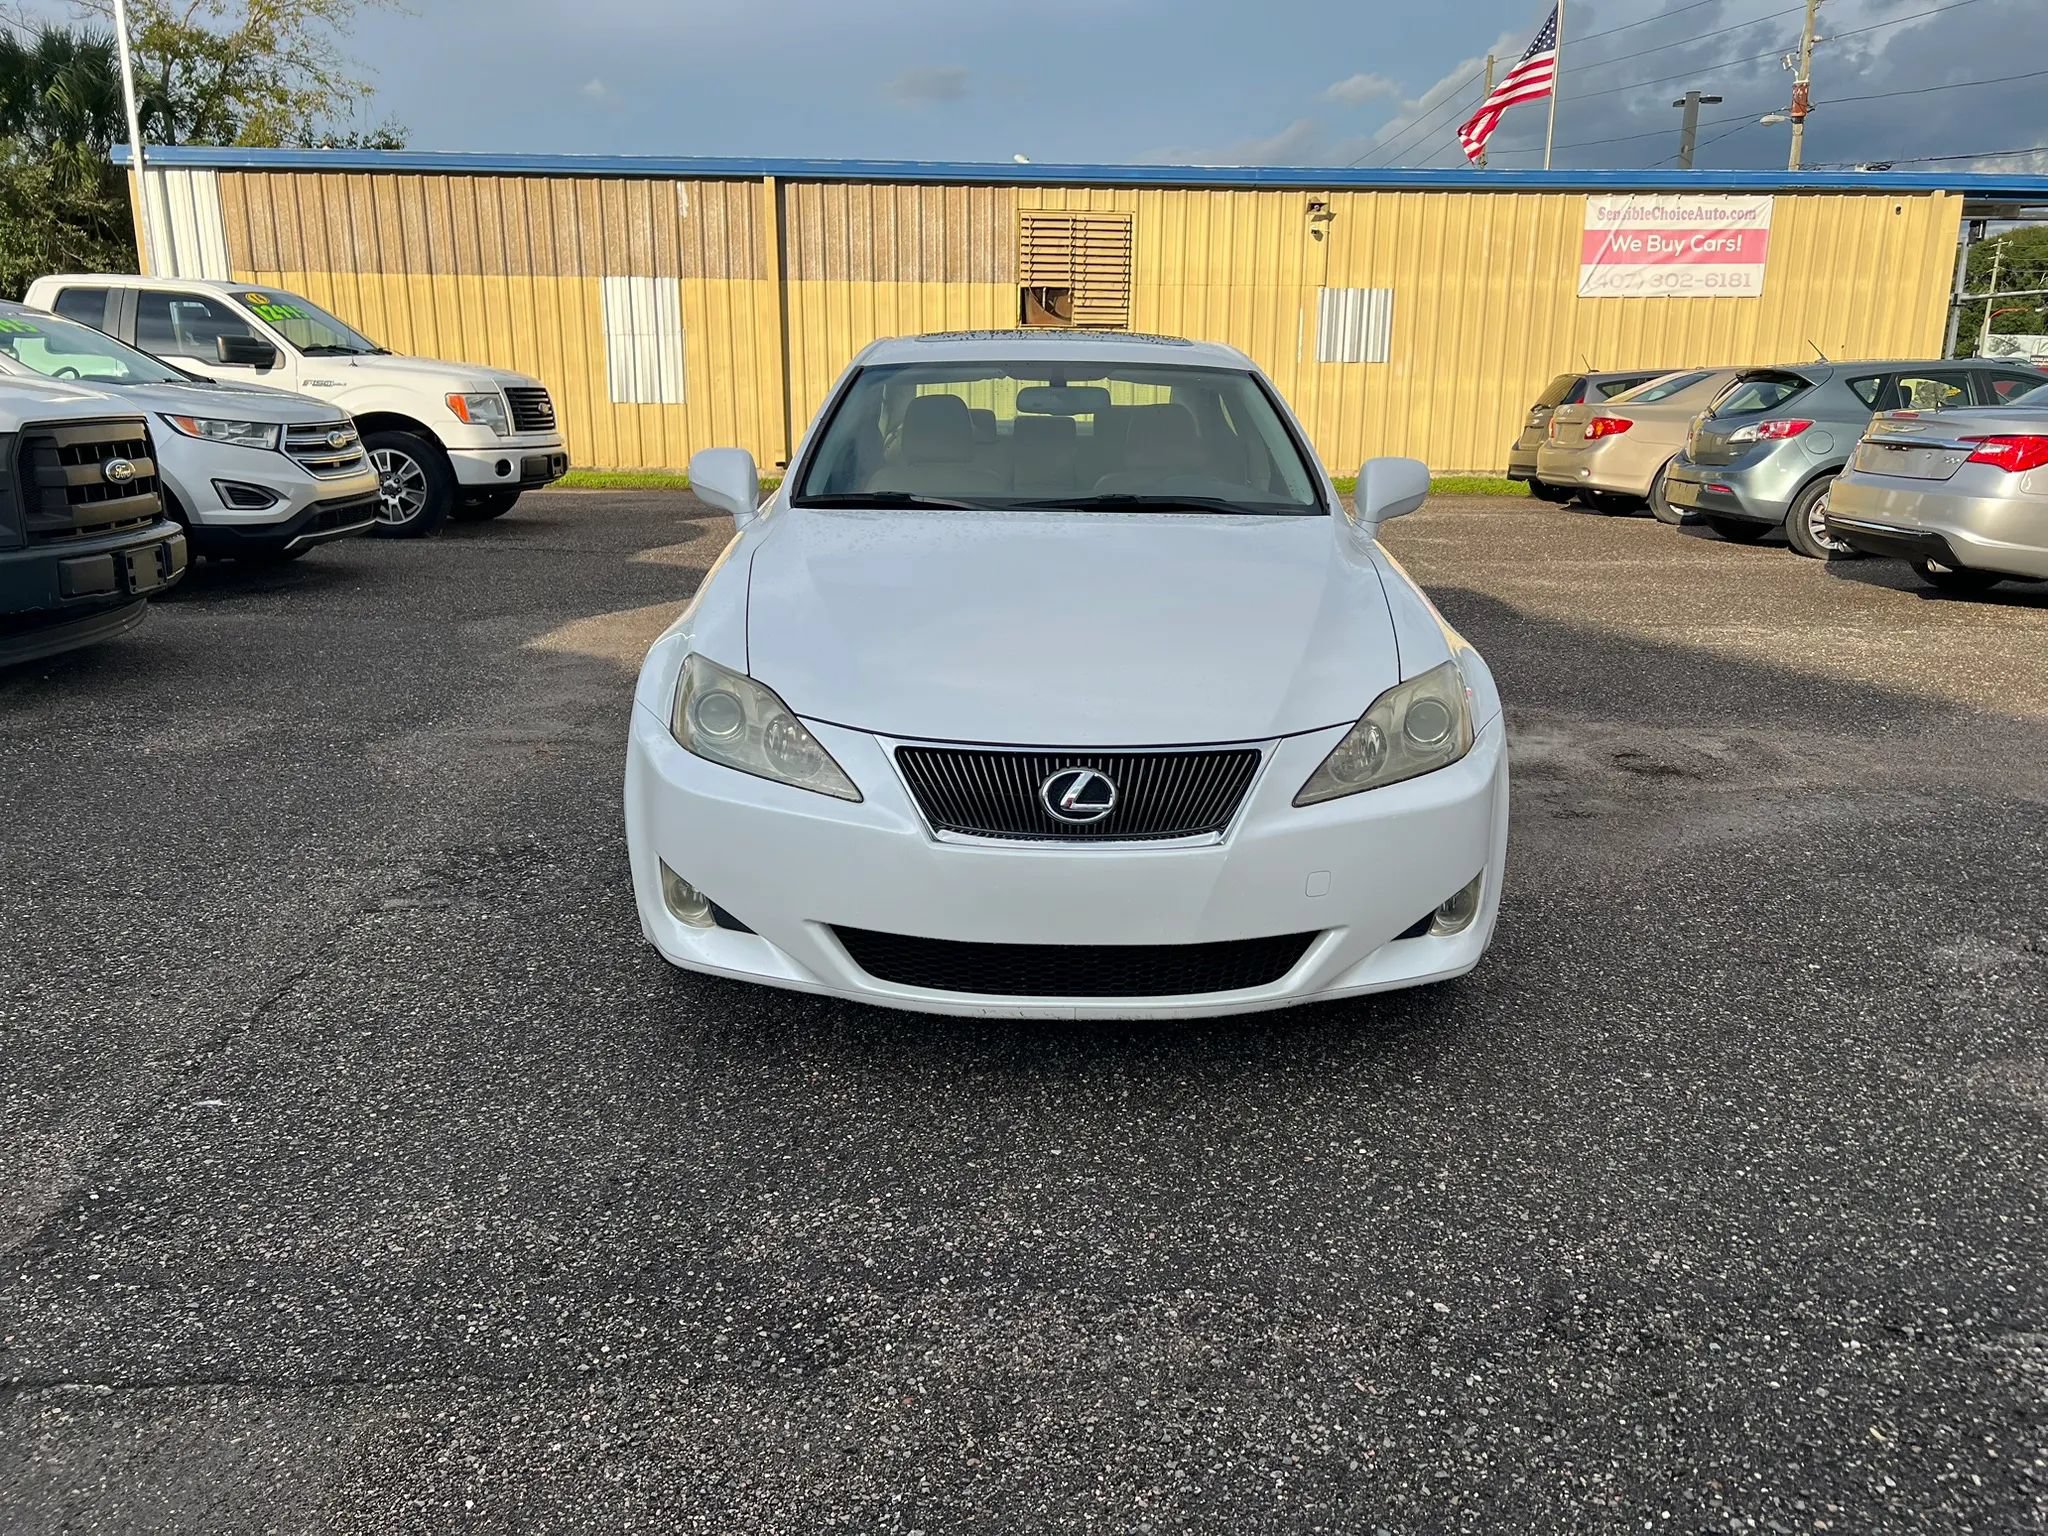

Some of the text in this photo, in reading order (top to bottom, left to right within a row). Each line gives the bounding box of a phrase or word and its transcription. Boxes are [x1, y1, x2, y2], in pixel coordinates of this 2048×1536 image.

[1610, 234, 1743, 257] We Buy Cars!
[1649, 272, 1752, 288] 302-6181
